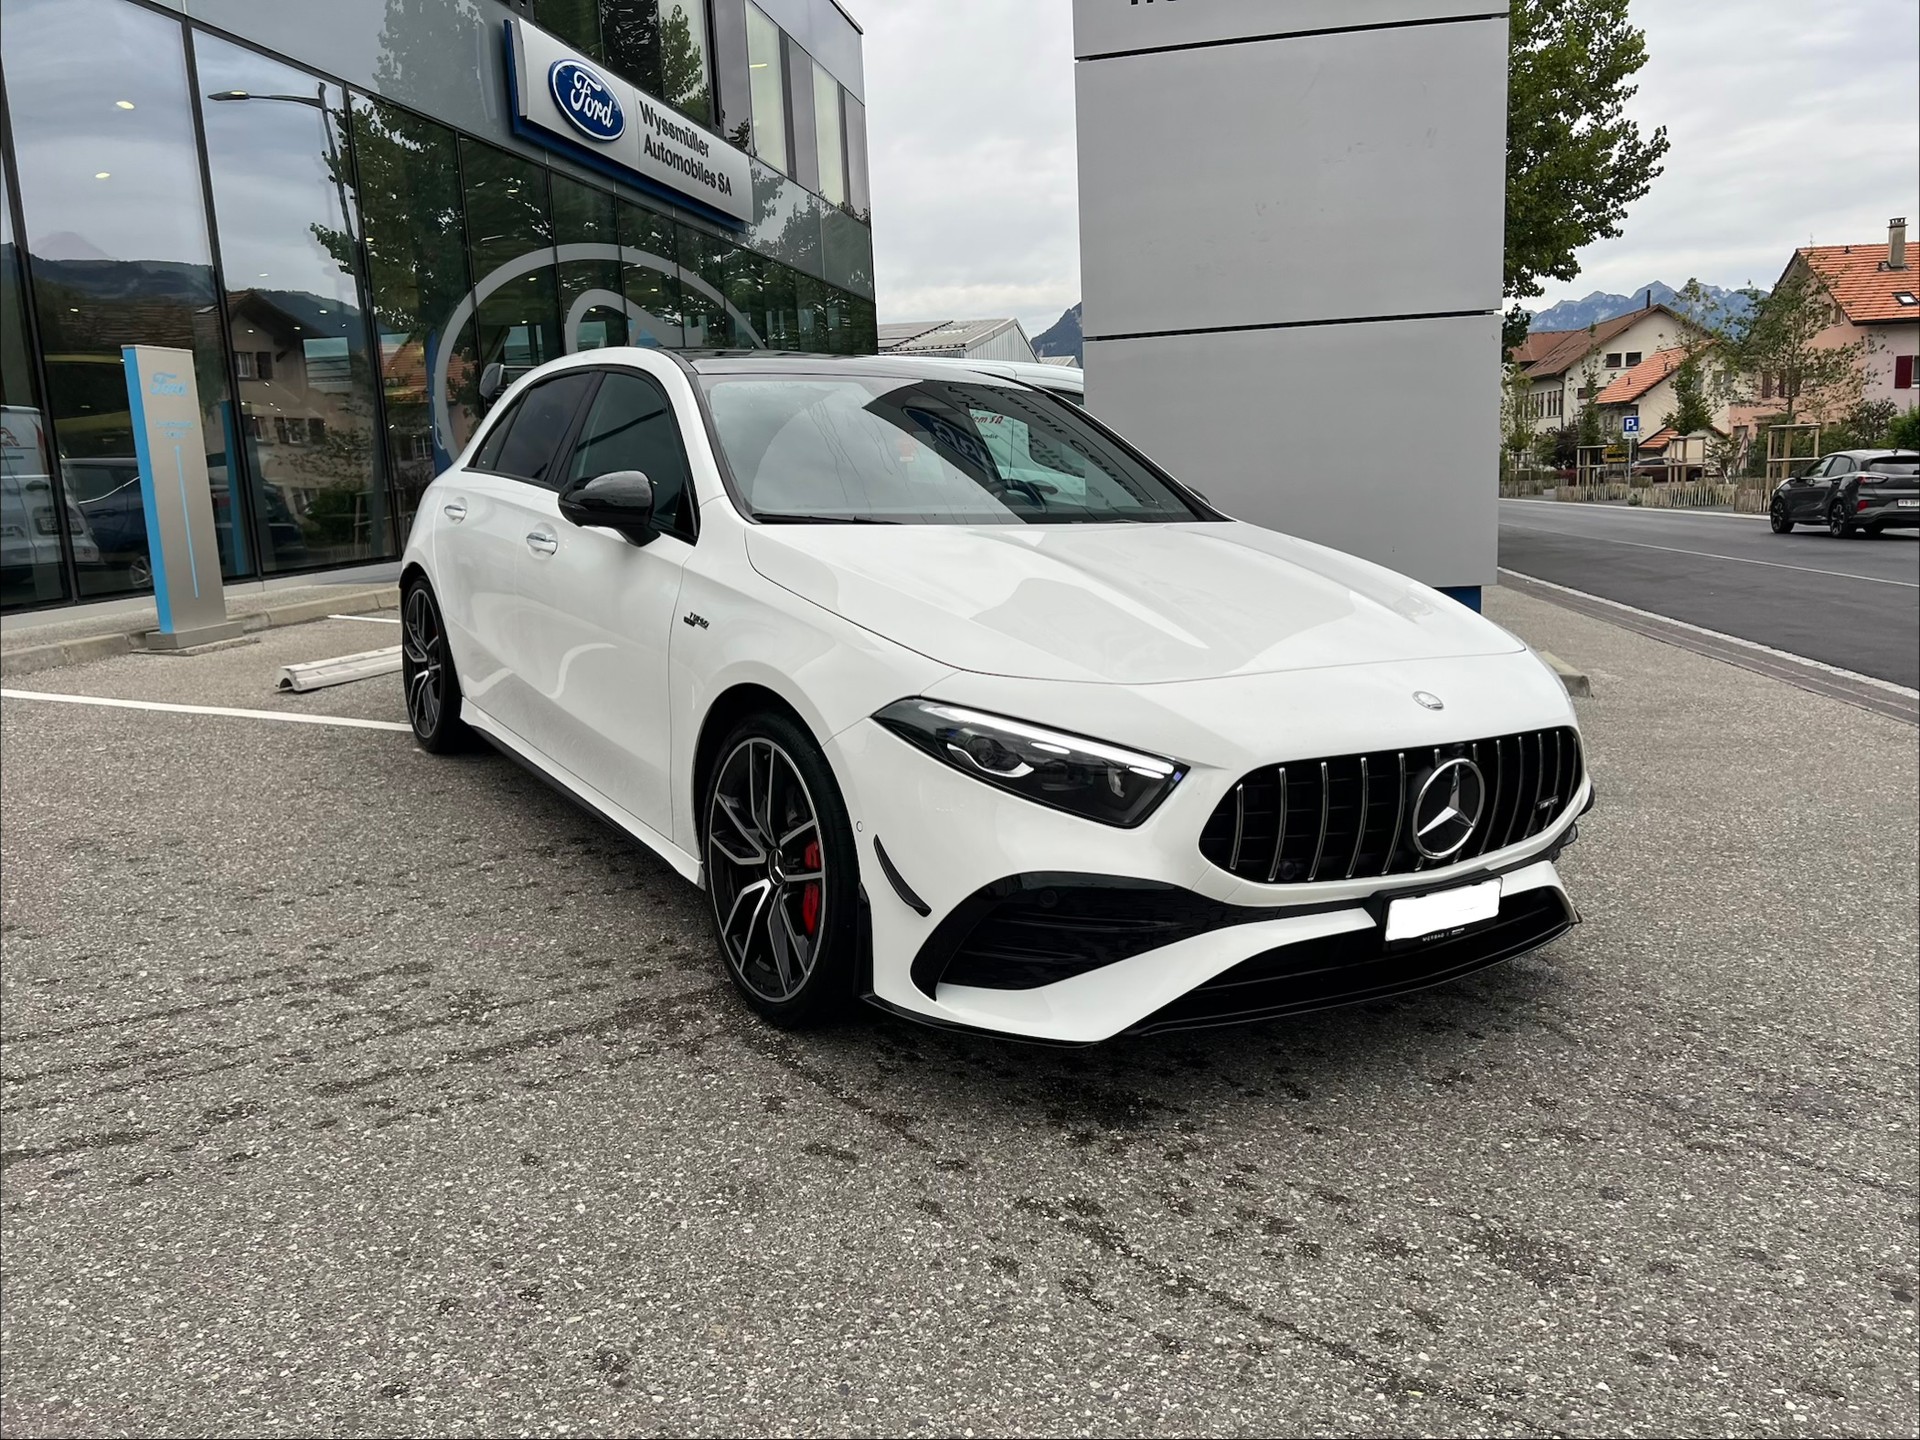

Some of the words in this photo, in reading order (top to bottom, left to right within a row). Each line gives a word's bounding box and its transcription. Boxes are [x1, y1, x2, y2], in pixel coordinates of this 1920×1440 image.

[570, 70, 614, 128] Ford
[639, 100, 710, 158] Wyssmüller
[643, 132, 717, 189] Automobiles
[717, 172, 733, 197] SA
[151, 372, 187, 396] Ford
[1626, 418, 1635, 431] P
